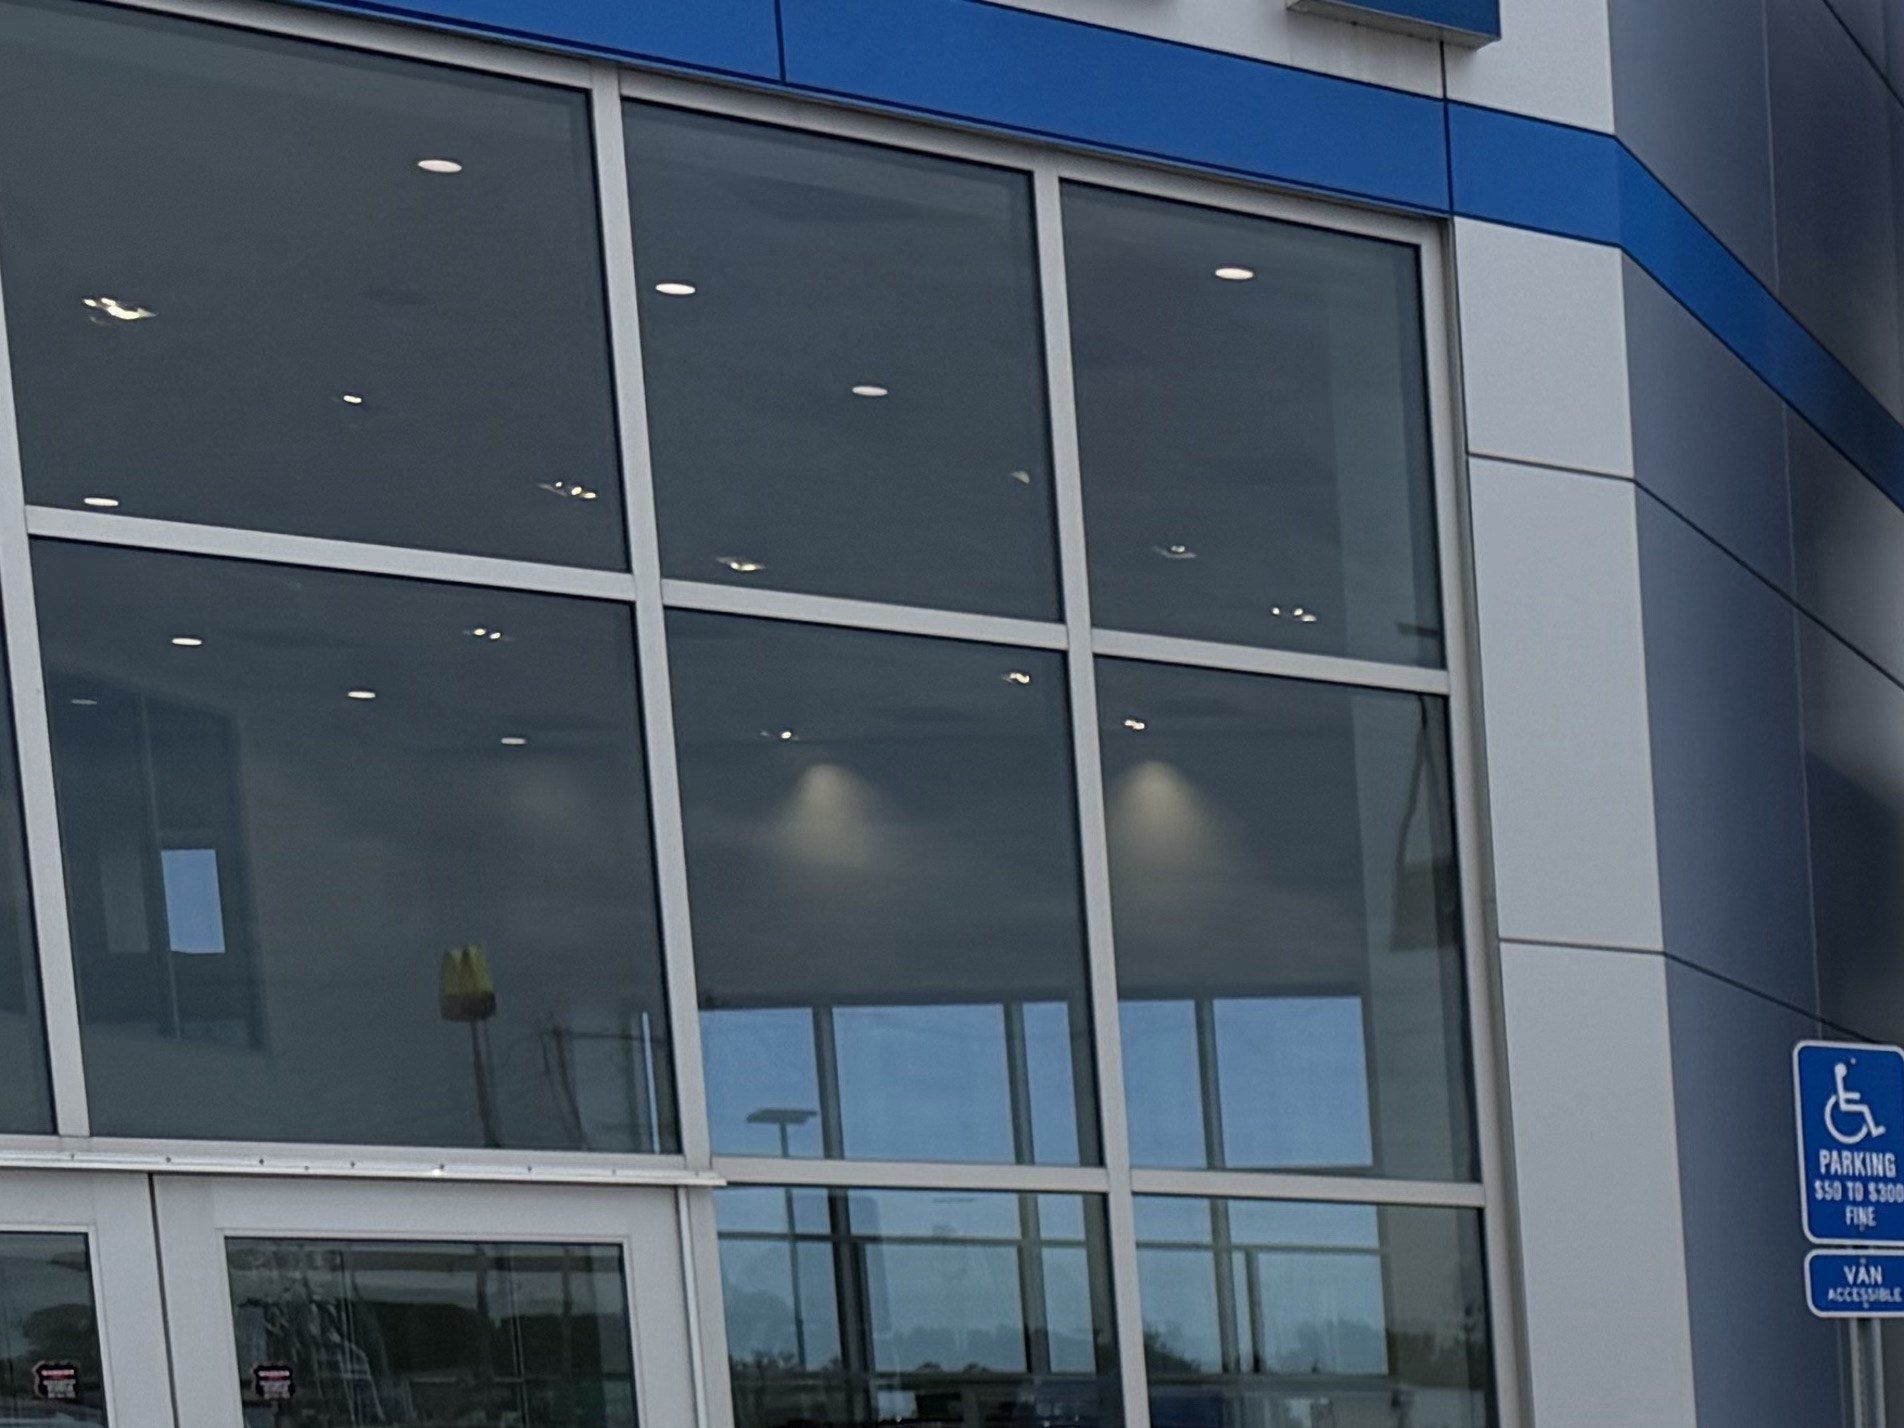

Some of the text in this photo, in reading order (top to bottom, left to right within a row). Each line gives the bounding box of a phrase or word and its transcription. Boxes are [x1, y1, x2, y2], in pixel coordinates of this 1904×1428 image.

[1819, 1149, 1896, 1177] PARKING
[1814, 1180, 1904, 1204] $50 TO $300
[1845, 1206, 1876, 1227] FINE
[1844, 1265, 1882, 1285] VAN
[1828, 1287, 1903, 1303] ACCESSIBLE
